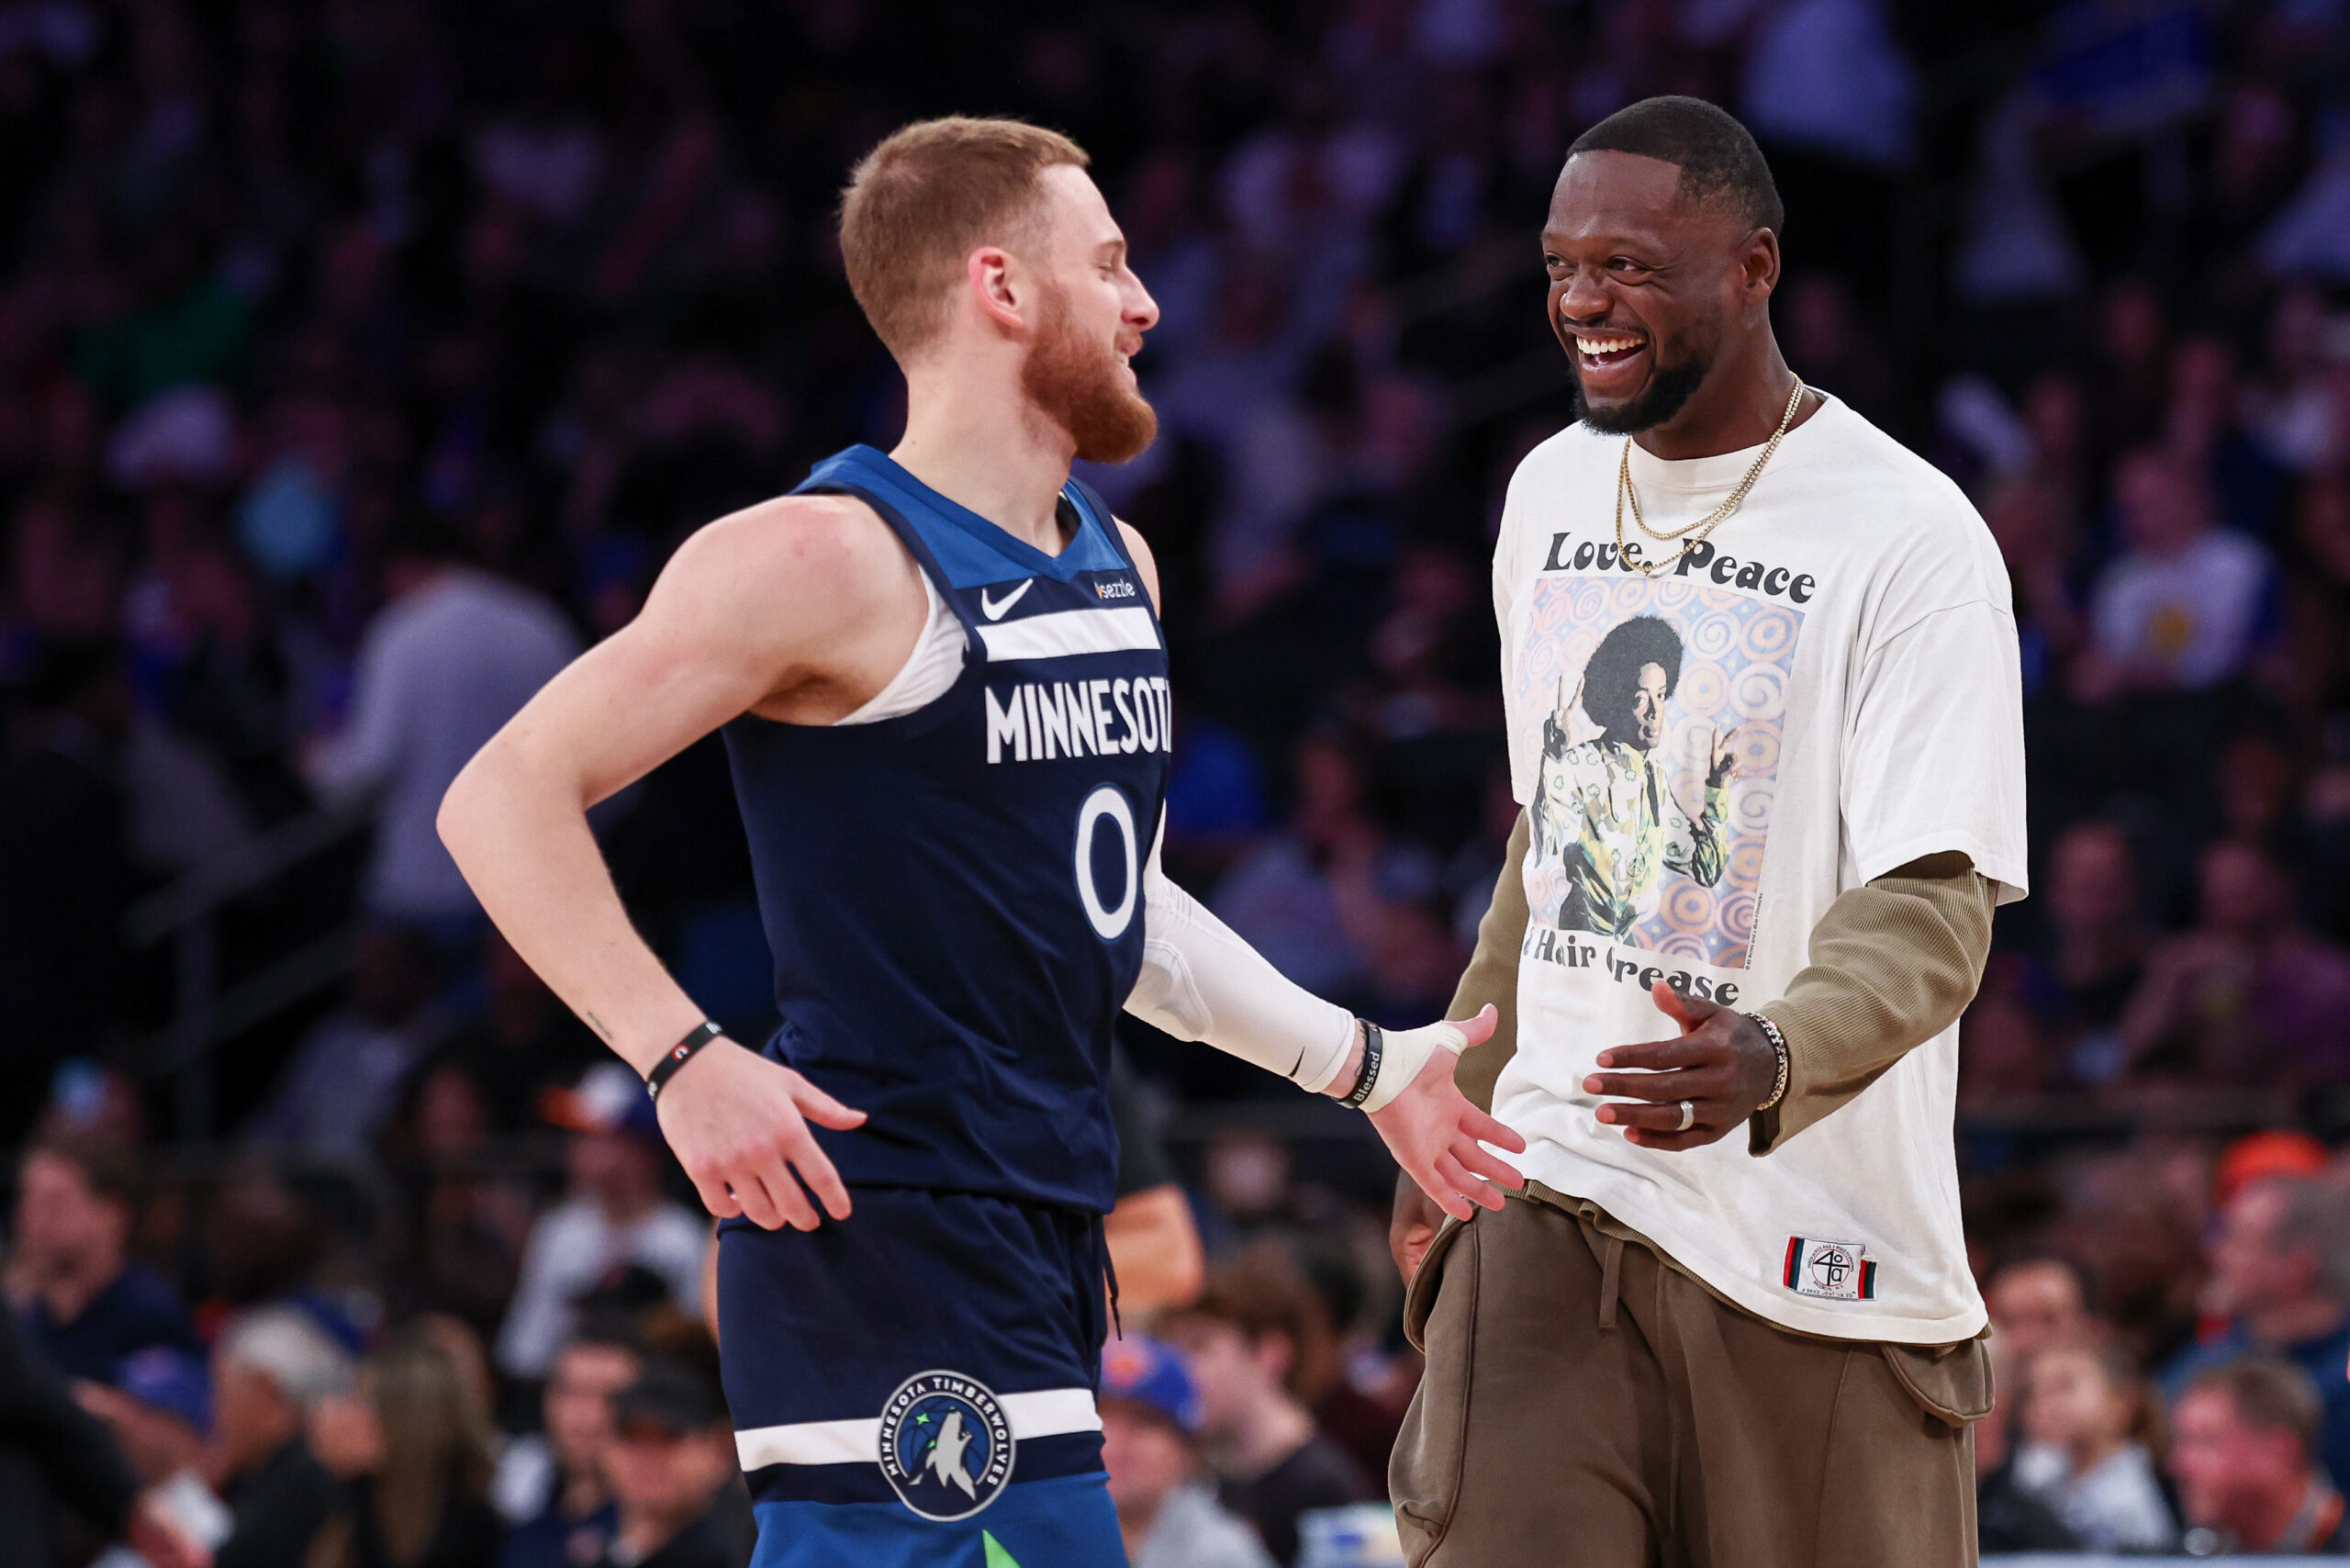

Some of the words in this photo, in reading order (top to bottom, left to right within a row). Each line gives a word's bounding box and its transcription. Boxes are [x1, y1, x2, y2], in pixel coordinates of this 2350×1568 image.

[1100, 577, 1136, 599] sezzle
[1543, 532, 1654, 576] Love,
[1673, 538, 1816, 603] Peace
[1074, 784, 1137, 940] 0
[1534, 928, 1596, 968] Hair
[1354, 1051, 1380, 1102] Blessed
[881, 1383, 926, 1477] MINNESOTA
[932, 1378, 1009, 1486] TIMBERWOLVES
